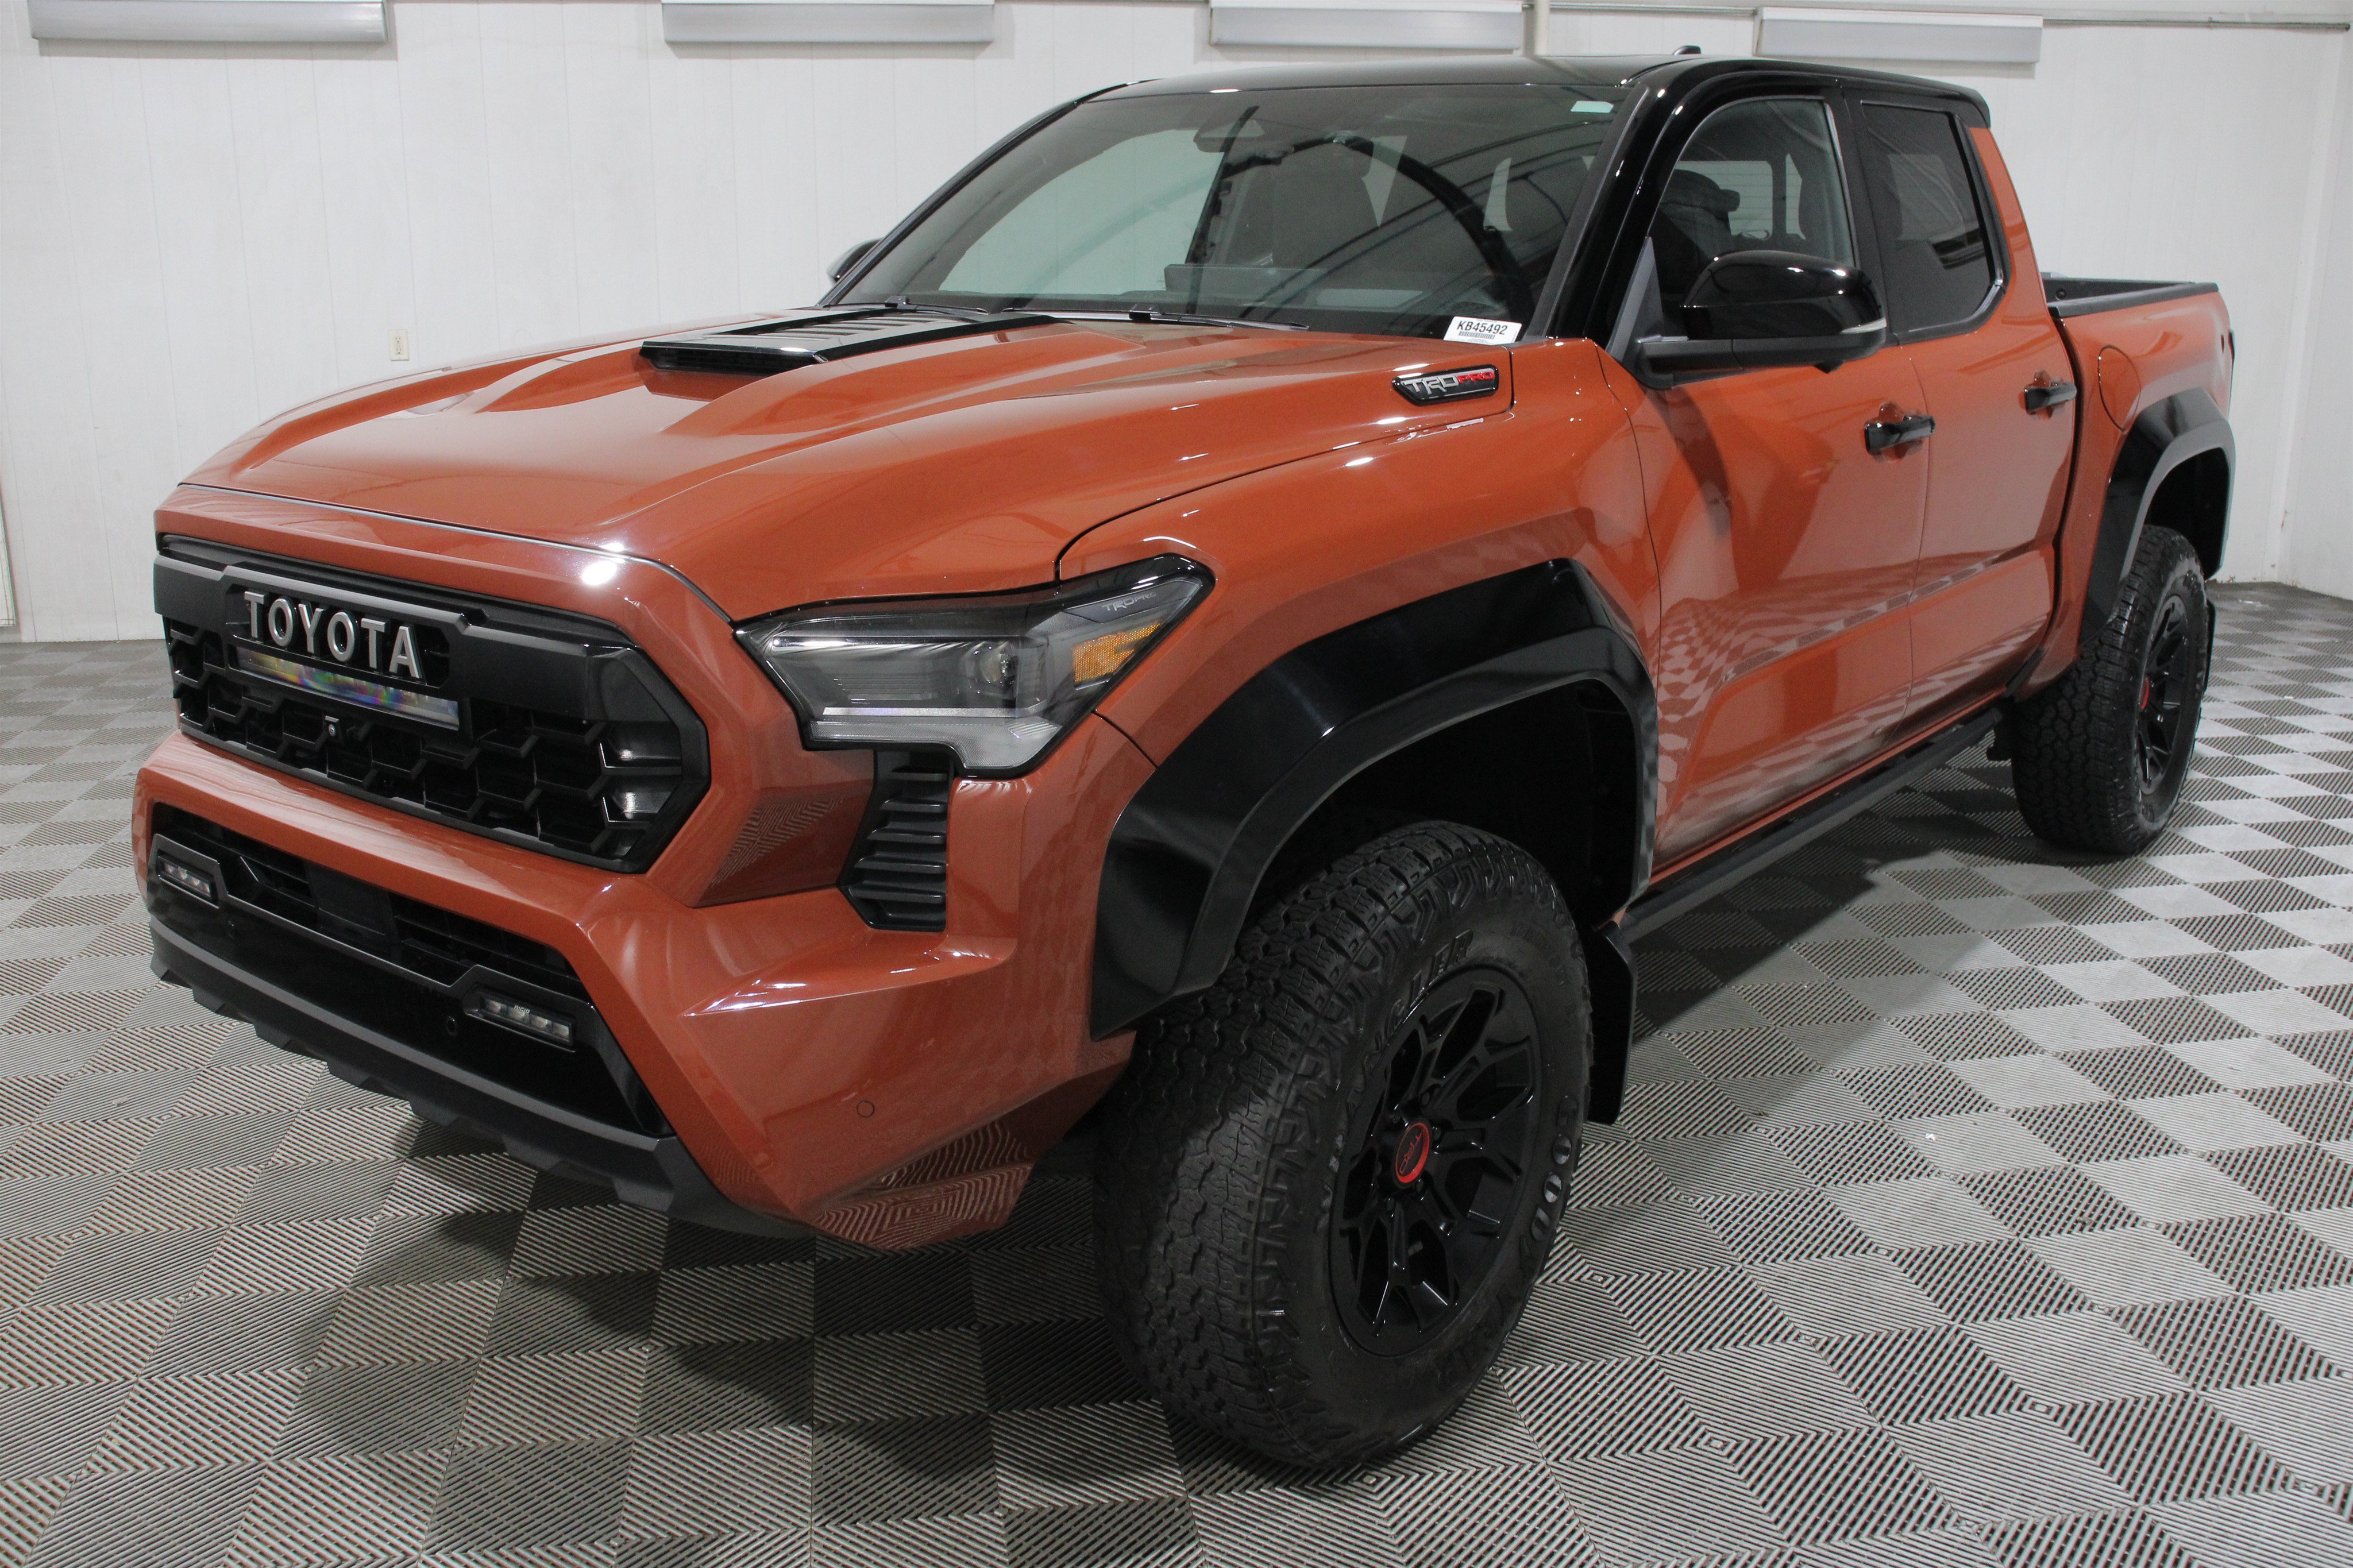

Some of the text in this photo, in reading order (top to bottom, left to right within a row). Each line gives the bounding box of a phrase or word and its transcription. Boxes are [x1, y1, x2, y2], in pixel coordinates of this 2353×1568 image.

[1456, 320, 1508, 335] KB45492
[1402, 376, 1459, 395] TRD
[1102, 598, 1135, 611] TRD
[244, 591, 423, 679] TOYOTA
[514, 1005, 530, 1014] RIGID
